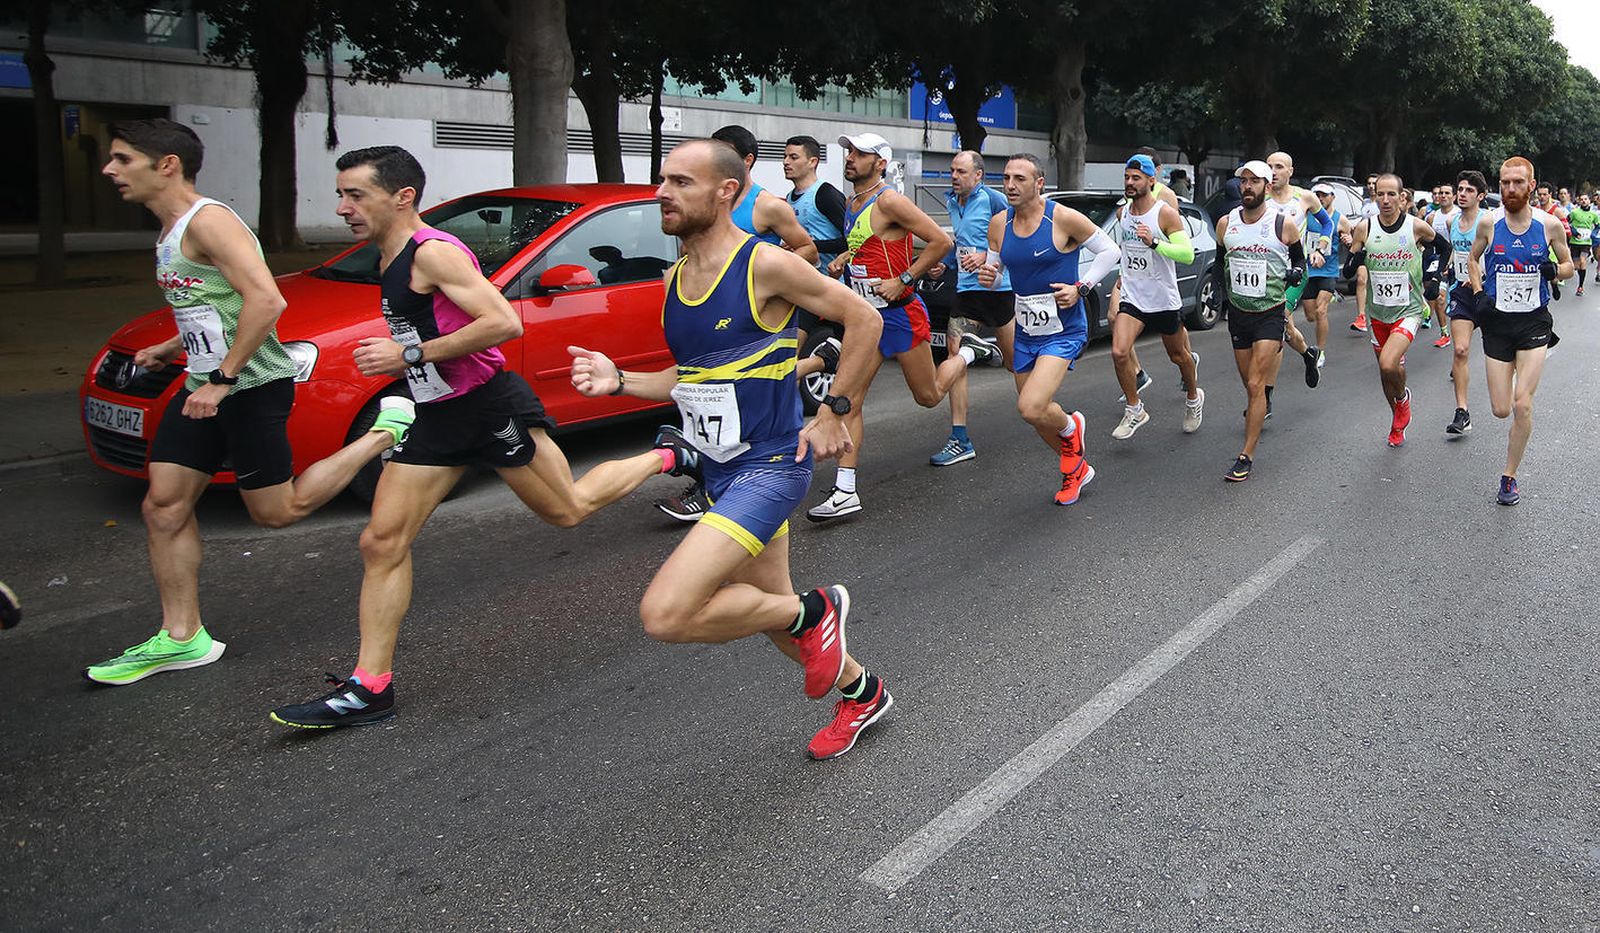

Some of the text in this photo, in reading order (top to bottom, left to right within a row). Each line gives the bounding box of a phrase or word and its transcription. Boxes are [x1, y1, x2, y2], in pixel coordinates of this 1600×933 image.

[1128, 256, 1148, 270] 259
[1235, 272, 1259, 288] 410
[1376, 284, 1402, 298] 387
[1021, 310, 1050, 326] 729
[932, 334, 944, 344] ZN
[90, 401, 140, 432] 6262 GHZ
[686, 411, 722, 446] 747
